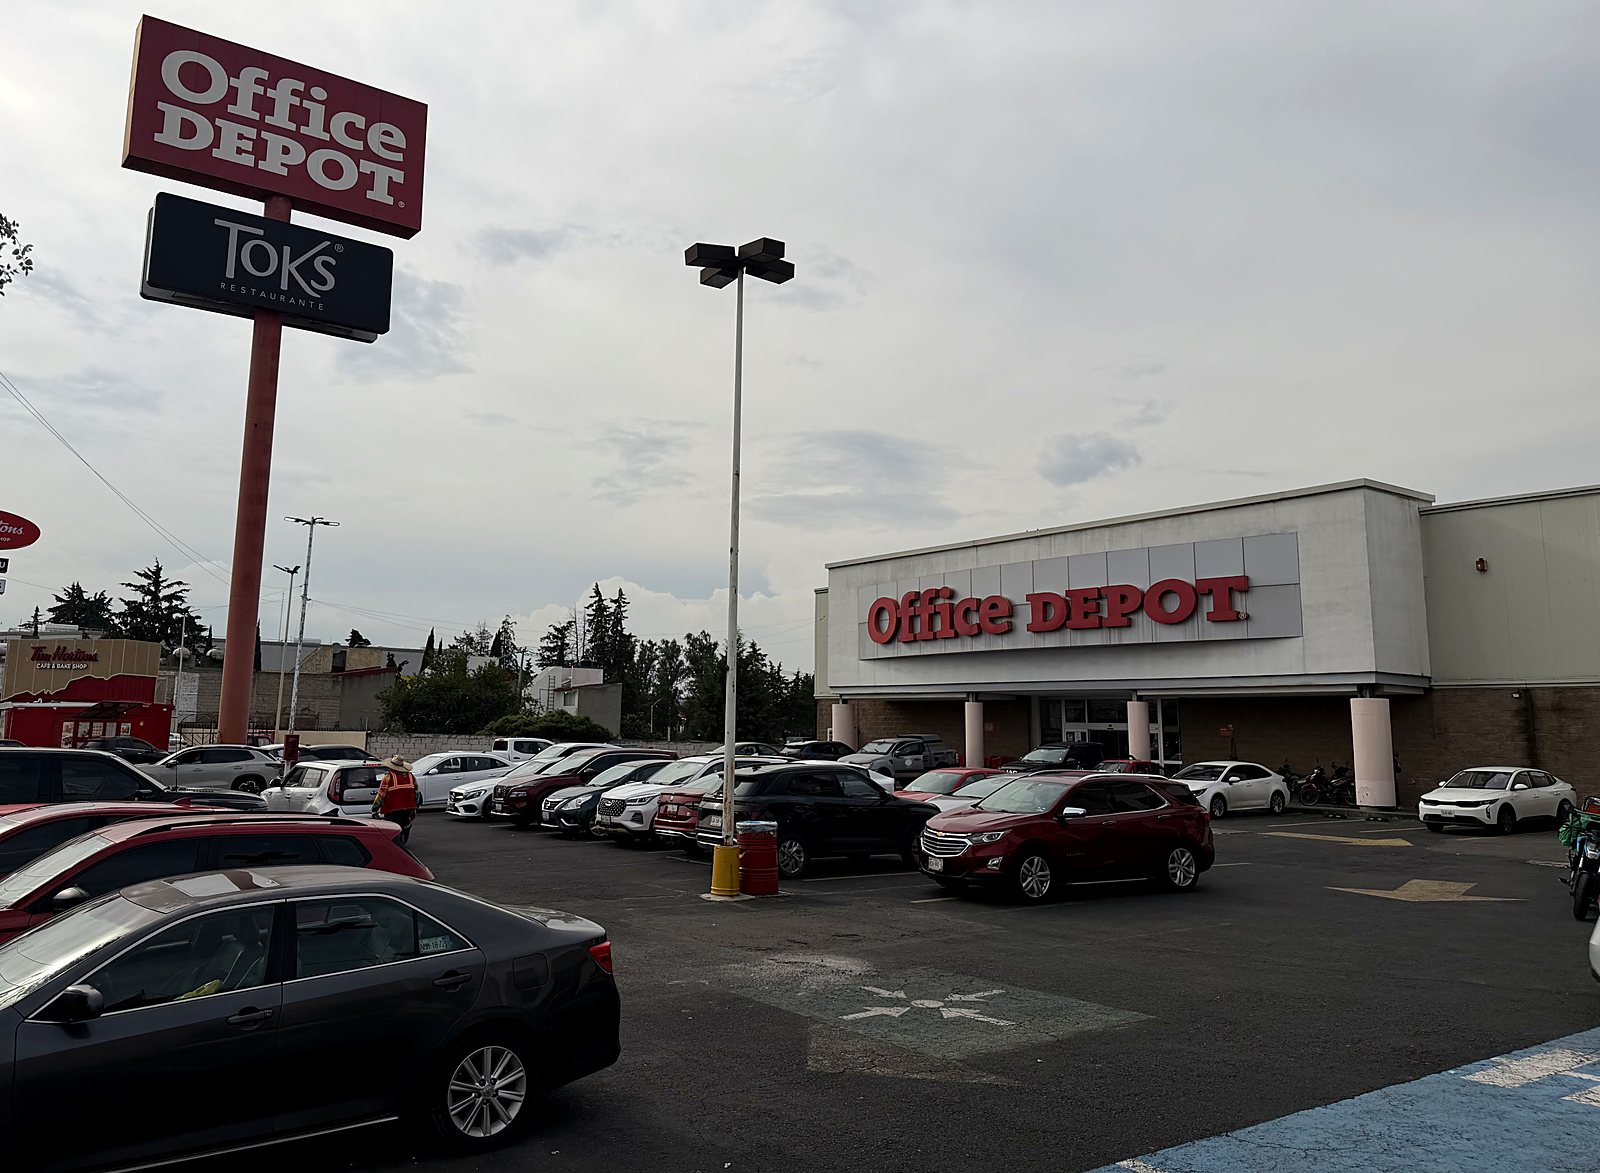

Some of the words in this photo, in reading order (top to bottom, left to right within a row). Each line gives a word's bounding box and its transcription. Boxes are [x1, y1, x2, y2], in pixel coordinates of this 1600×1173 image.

[161, 50, 407, 162] Office
[153, 101, 405, 206] DEPOT
[220, 282, 325, 311] RESTAURANTE
[867, 586, 1013, 645] Office
[1026, 575, 1249, 634] DEPOT
[31, 646, 52, 661] Tim
[52, 645, 98, 662] Hortons
